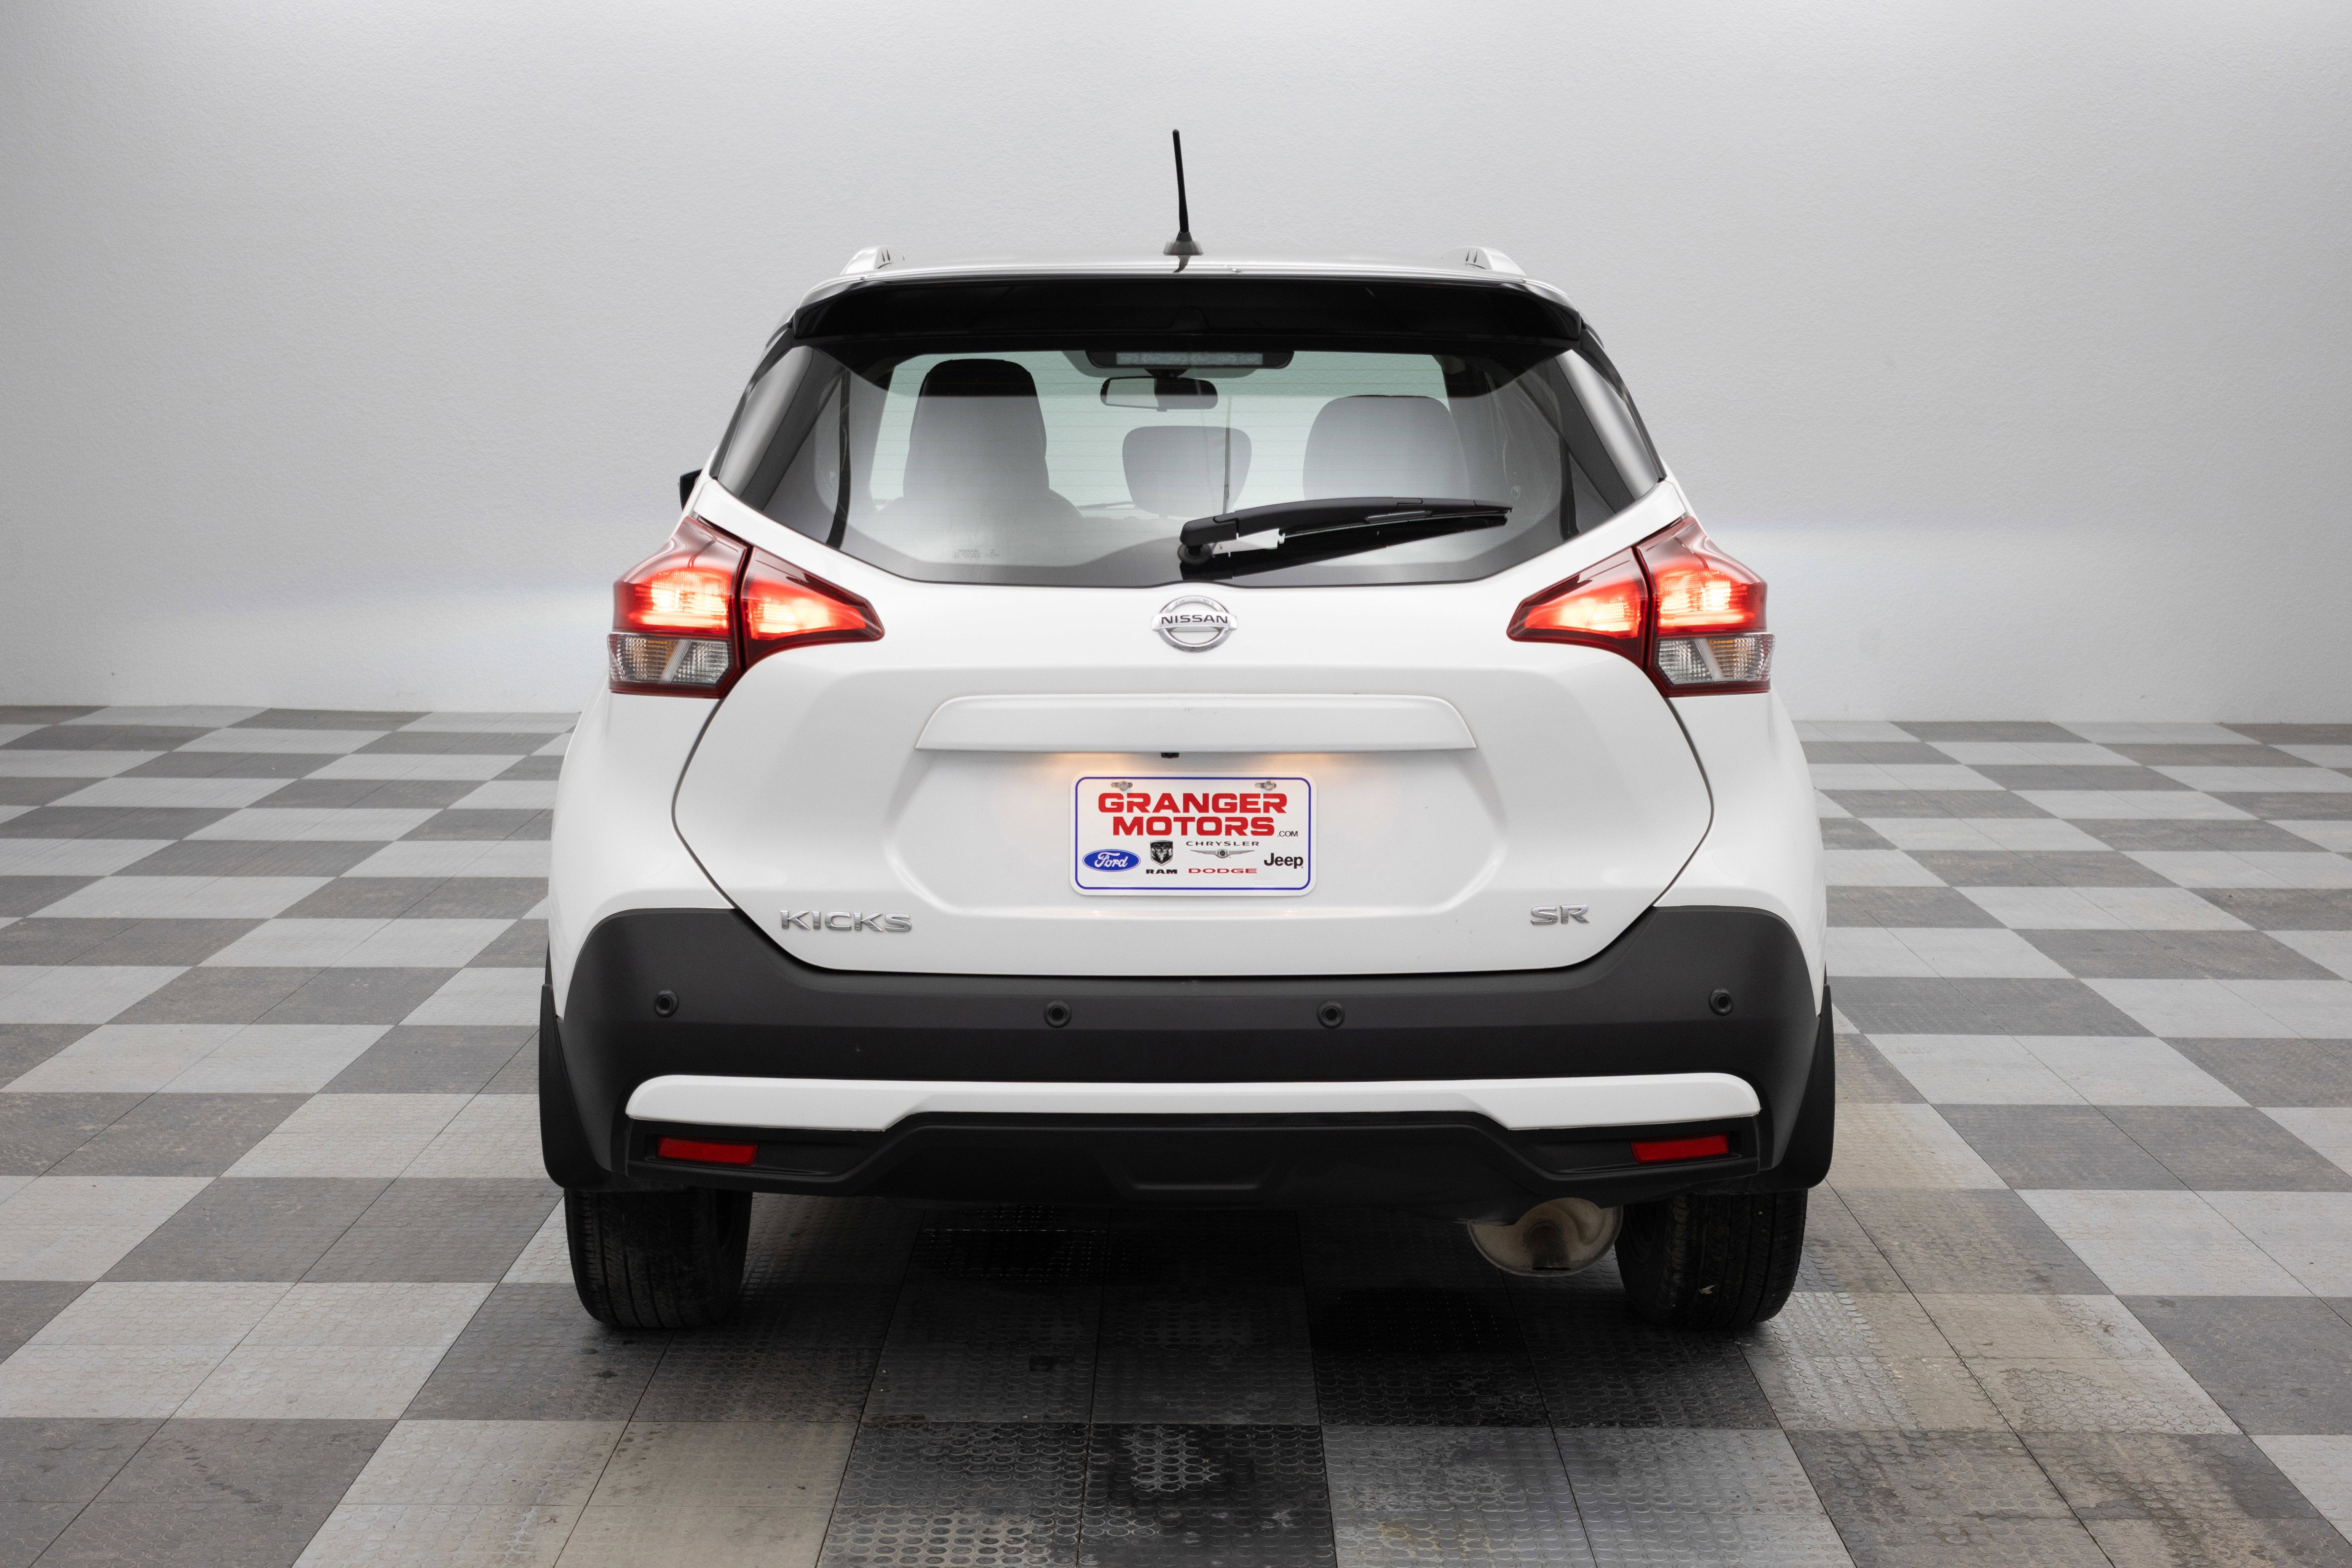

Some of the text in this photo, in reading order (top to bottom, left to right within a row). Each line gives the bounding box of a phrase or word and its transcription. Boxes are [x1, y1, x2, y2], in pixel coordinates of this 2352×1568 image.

[1161, 615, 1228, 625] NISSAN
[1098, 793, 1287, 813] GRANGER
[1113, 817, 1275, 836] MOTORS
[1094, 852, 1128, 867] Ford
[1264, 853, 1303, 869] Jeep
[780, 910, 912, 932] KICKS
[1531, 904, 1589, 925] SR
